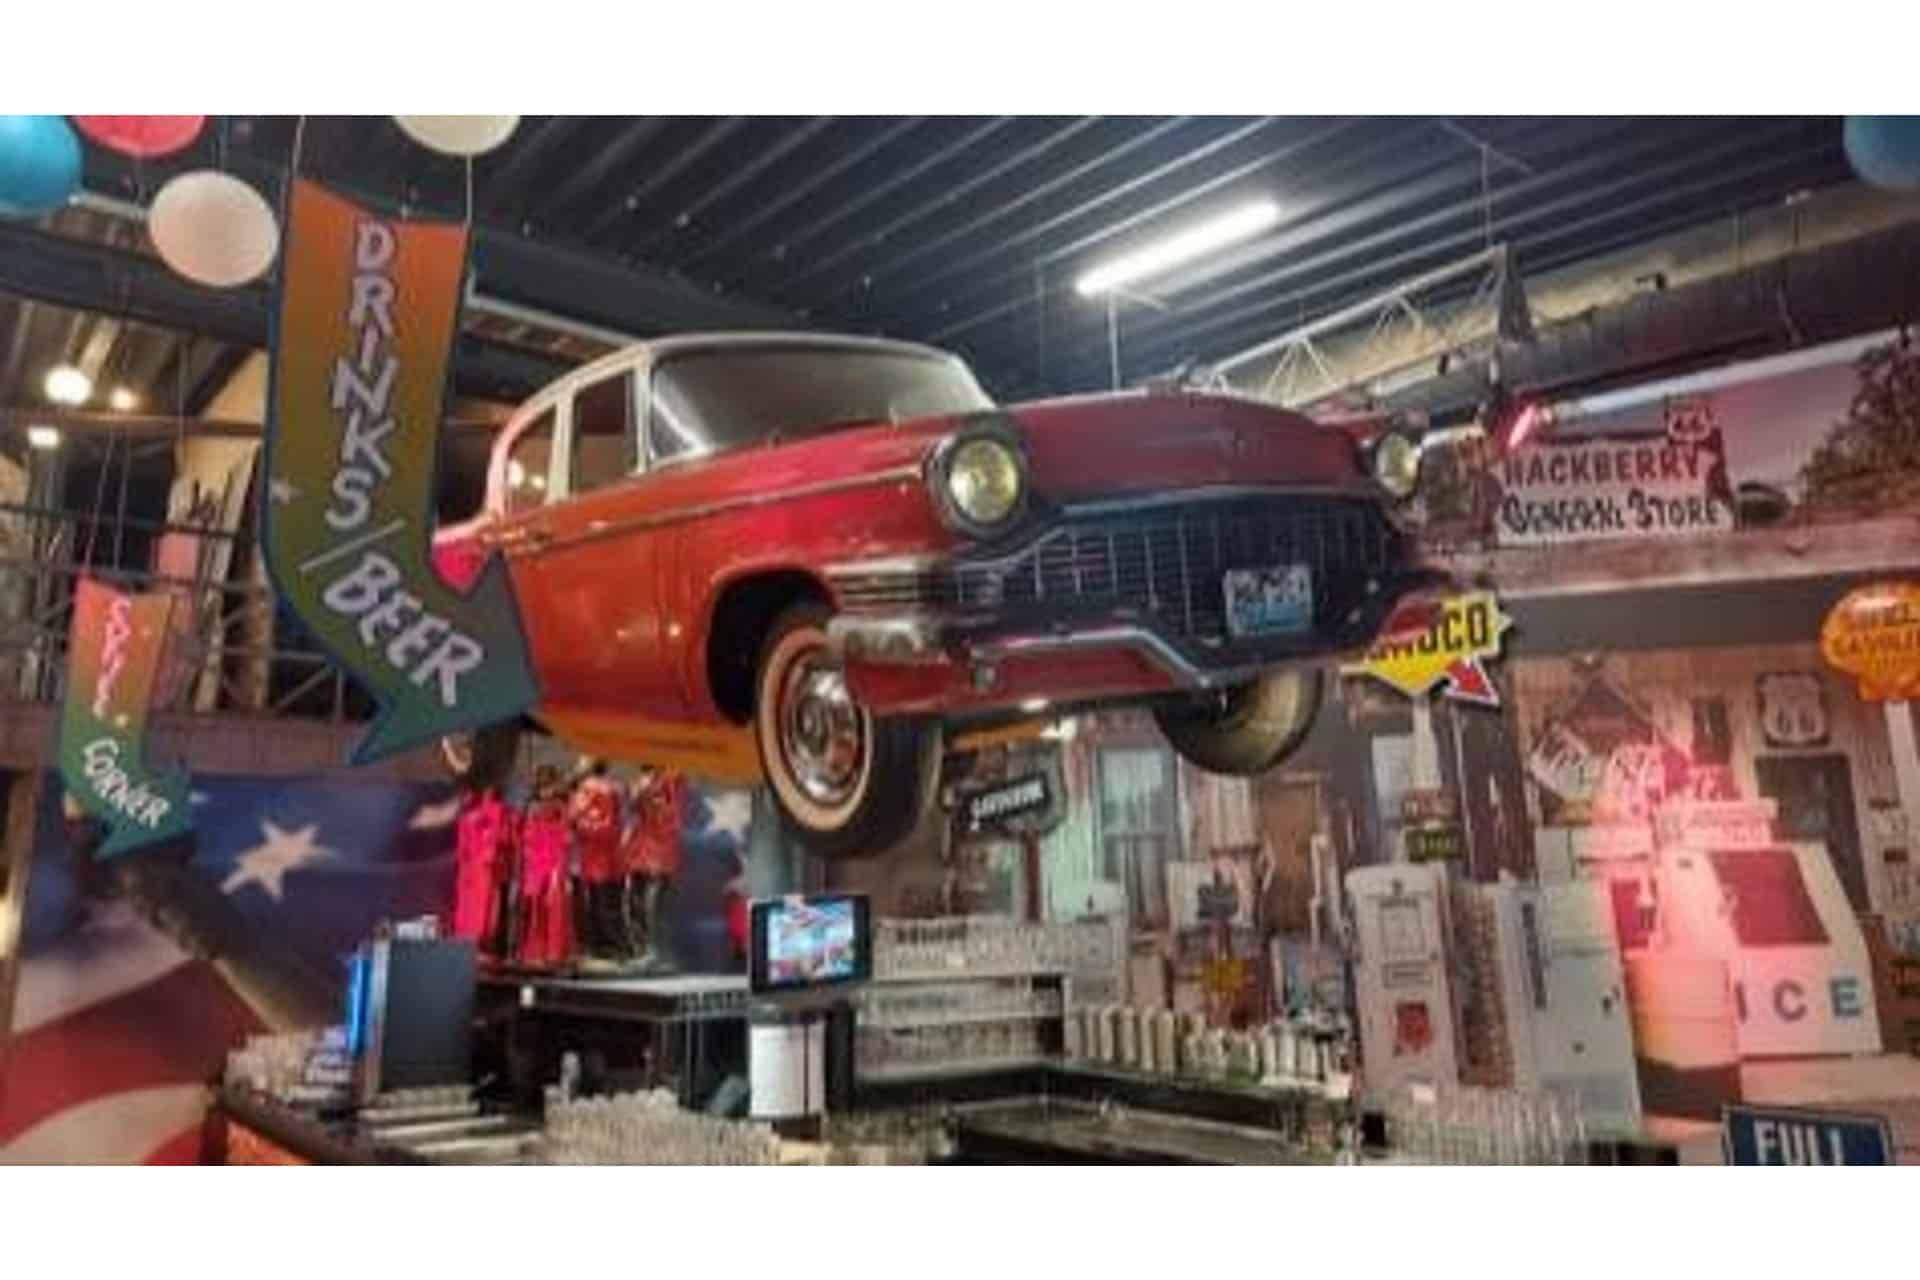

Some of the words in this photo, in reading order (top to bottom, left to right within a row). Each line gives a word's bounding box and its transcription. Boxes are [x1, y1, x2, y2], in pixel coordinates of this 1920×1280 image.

[1504, 447, 1702, 487] HACKBERRY
[1629, 488, 1719, 530] STORE
[83, 737, 169, 830] CORNER
[1734, 974, 1864, 1024] ICE
